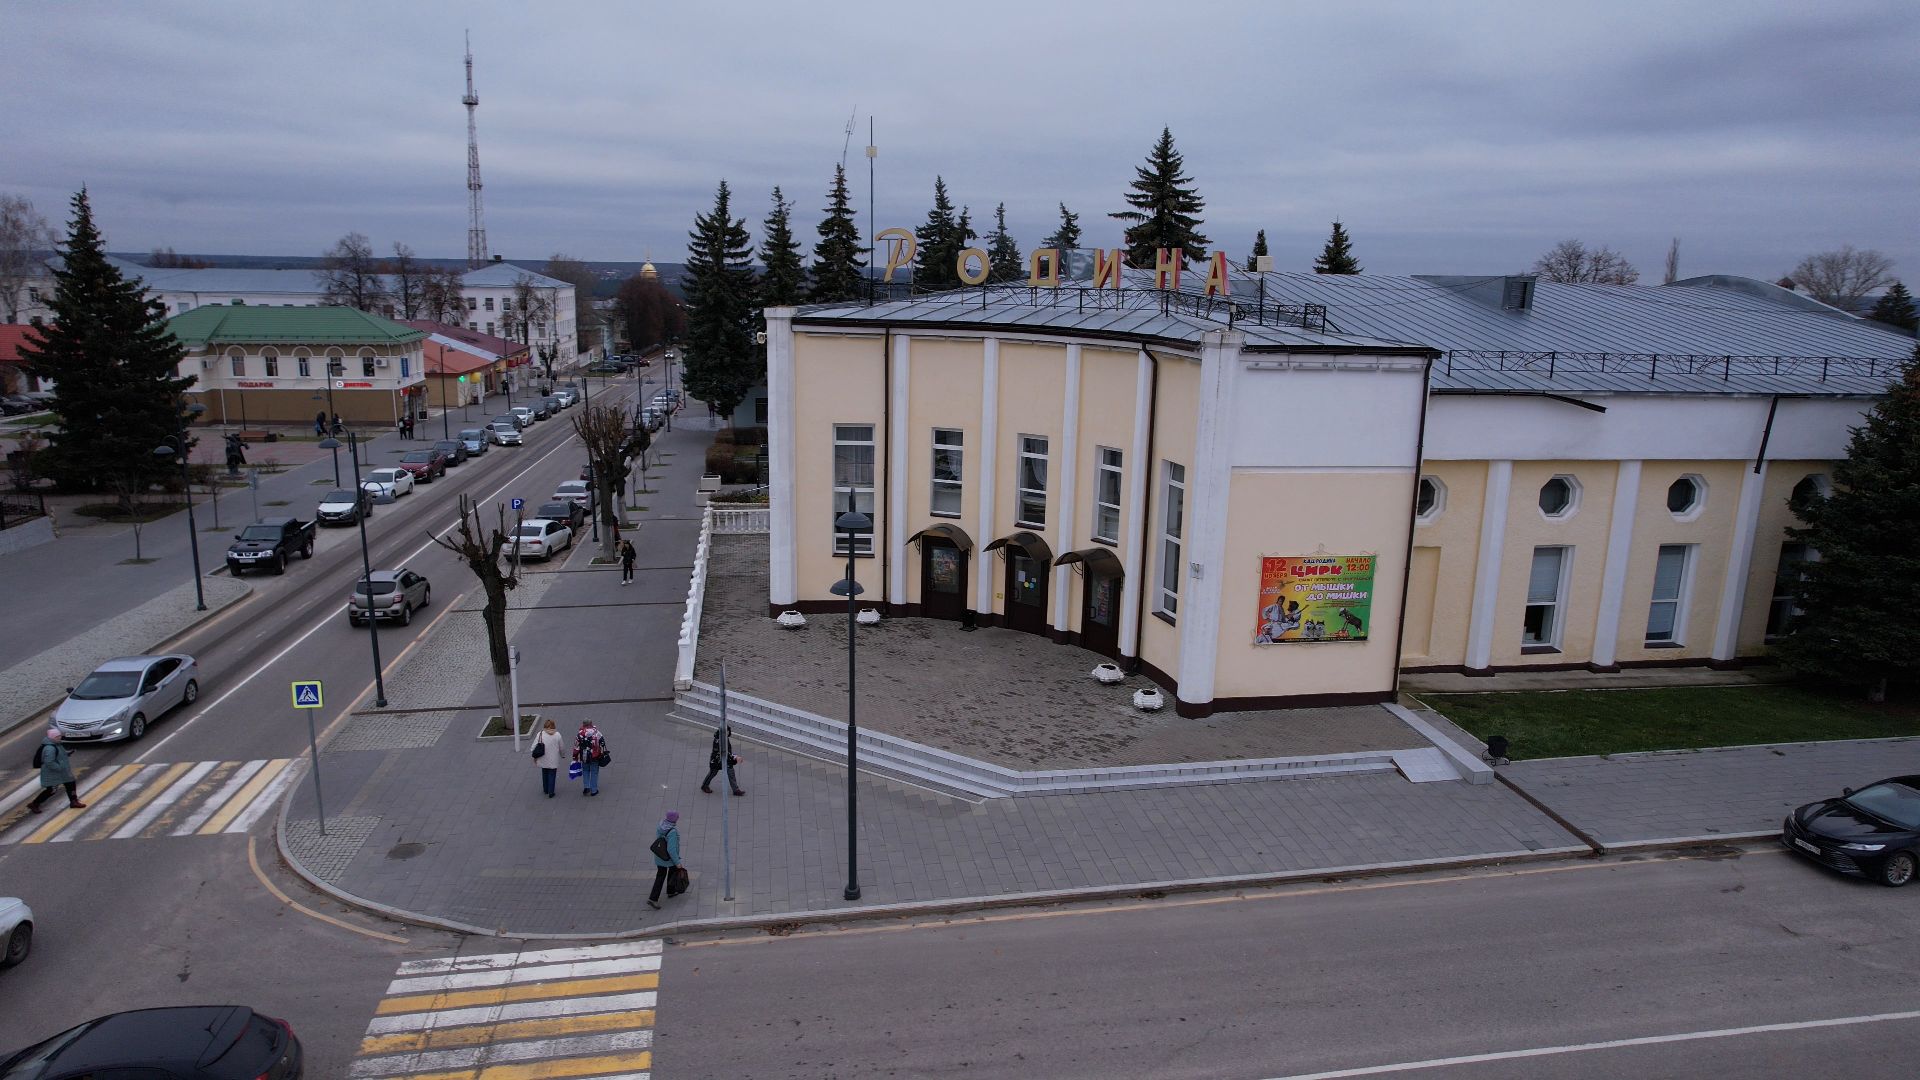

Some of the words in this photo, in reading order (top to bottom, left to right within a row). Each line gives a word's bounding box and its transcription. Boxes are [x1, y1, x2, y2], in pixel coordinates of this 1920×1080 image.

[875, 228, 1231, 296] РОДИНА
[1264, 558, 1287, 573] 12
[1346, 563, 1370, 572] 12:00
[1290, 565, 1344, 578] ЦИРК
[1294, 584, 1309, 592] ОТ
[1311, 583, 1354, 592] МЫШКИ
[1305, 592, 1324, 601] ДО
[1326, 591, 1369, 600] МИШКИ
